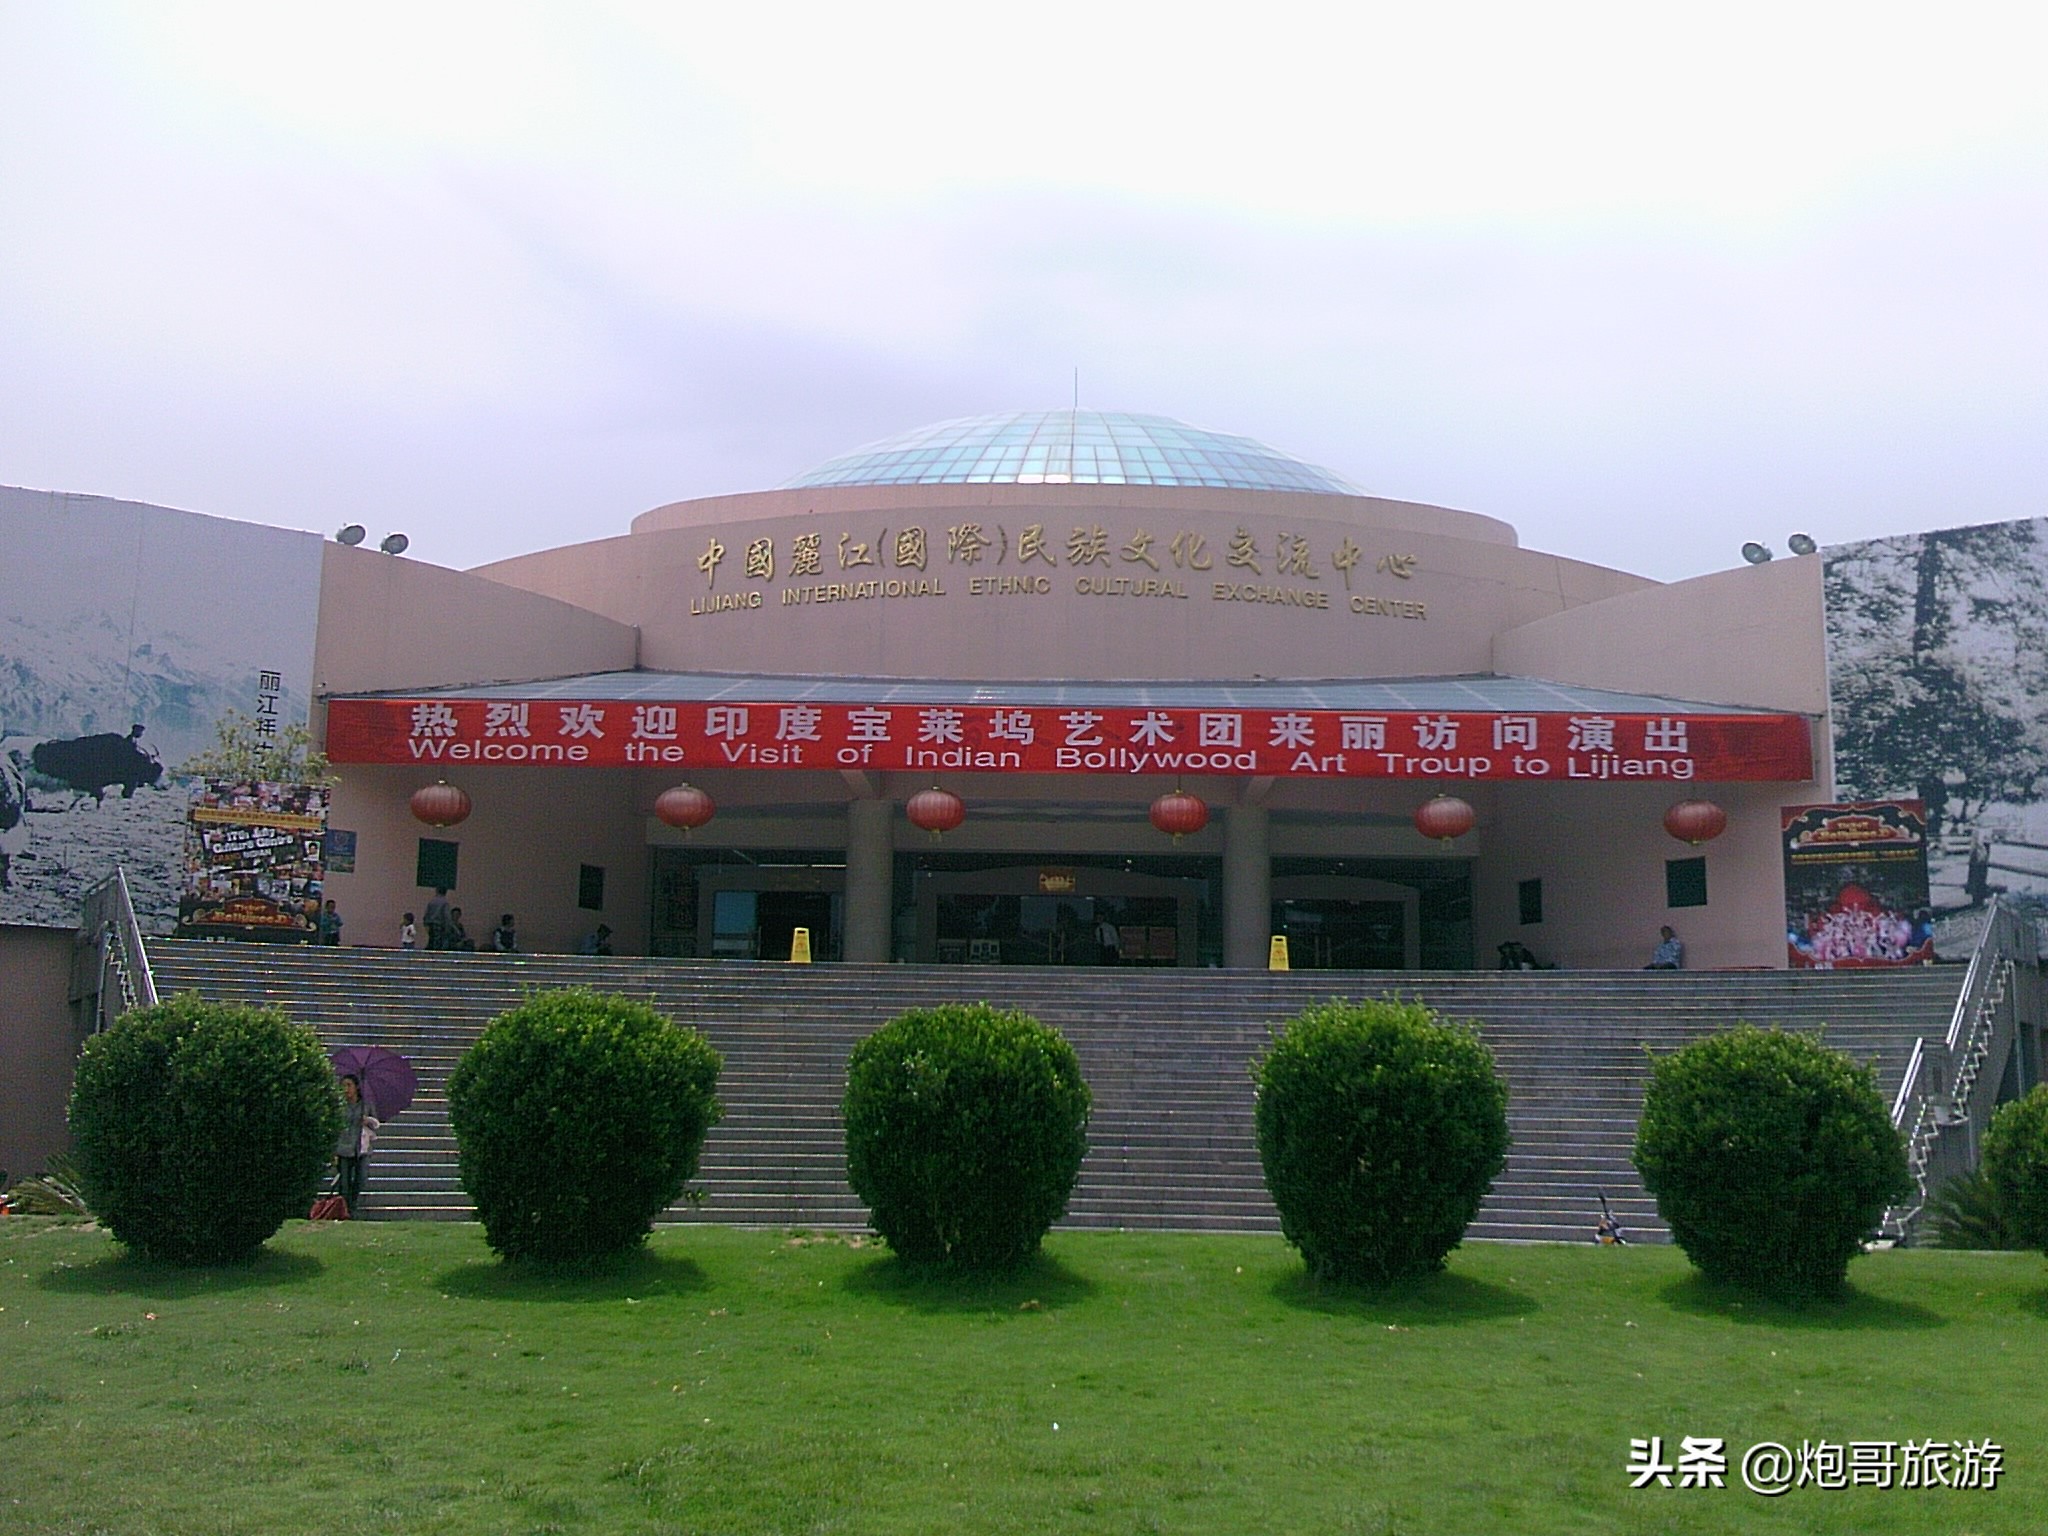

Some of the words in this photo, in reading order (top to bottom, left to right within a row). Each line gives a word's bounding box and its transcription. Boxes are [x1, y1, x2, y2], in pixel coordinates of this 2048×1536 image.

[690, 591, 762, 615] LIJIANG
[782, 577, 946, 606] INTERNATIONAL
[969, 576, 1051, 596] ETHNIC
[1074, 576, 1188, 599] CULTURAL
[1213, 582, 1329, 609] EXCHANGE
[1350, 595, 1428, 620] CENTER
[410, 702, 1689, 753] 热烈欢迎印度宝莱坞艺术团来丽访问演出
[408, 738, 589, 760] Welcome
[624, 741, 684, 762] the
[720, 741, 803, 763] Visit
[836, 743, 873, 764] of
[906, 745, 1020, 768] Indian
[1056, 747, 1257, 773] Bollywood
[1290, 751, 1347, 772] Art
[1377, 753, 1492, 777] Troup
[1511, 755, 1549, 775] to
[1567, 754, 1694, 779] Lijiang
